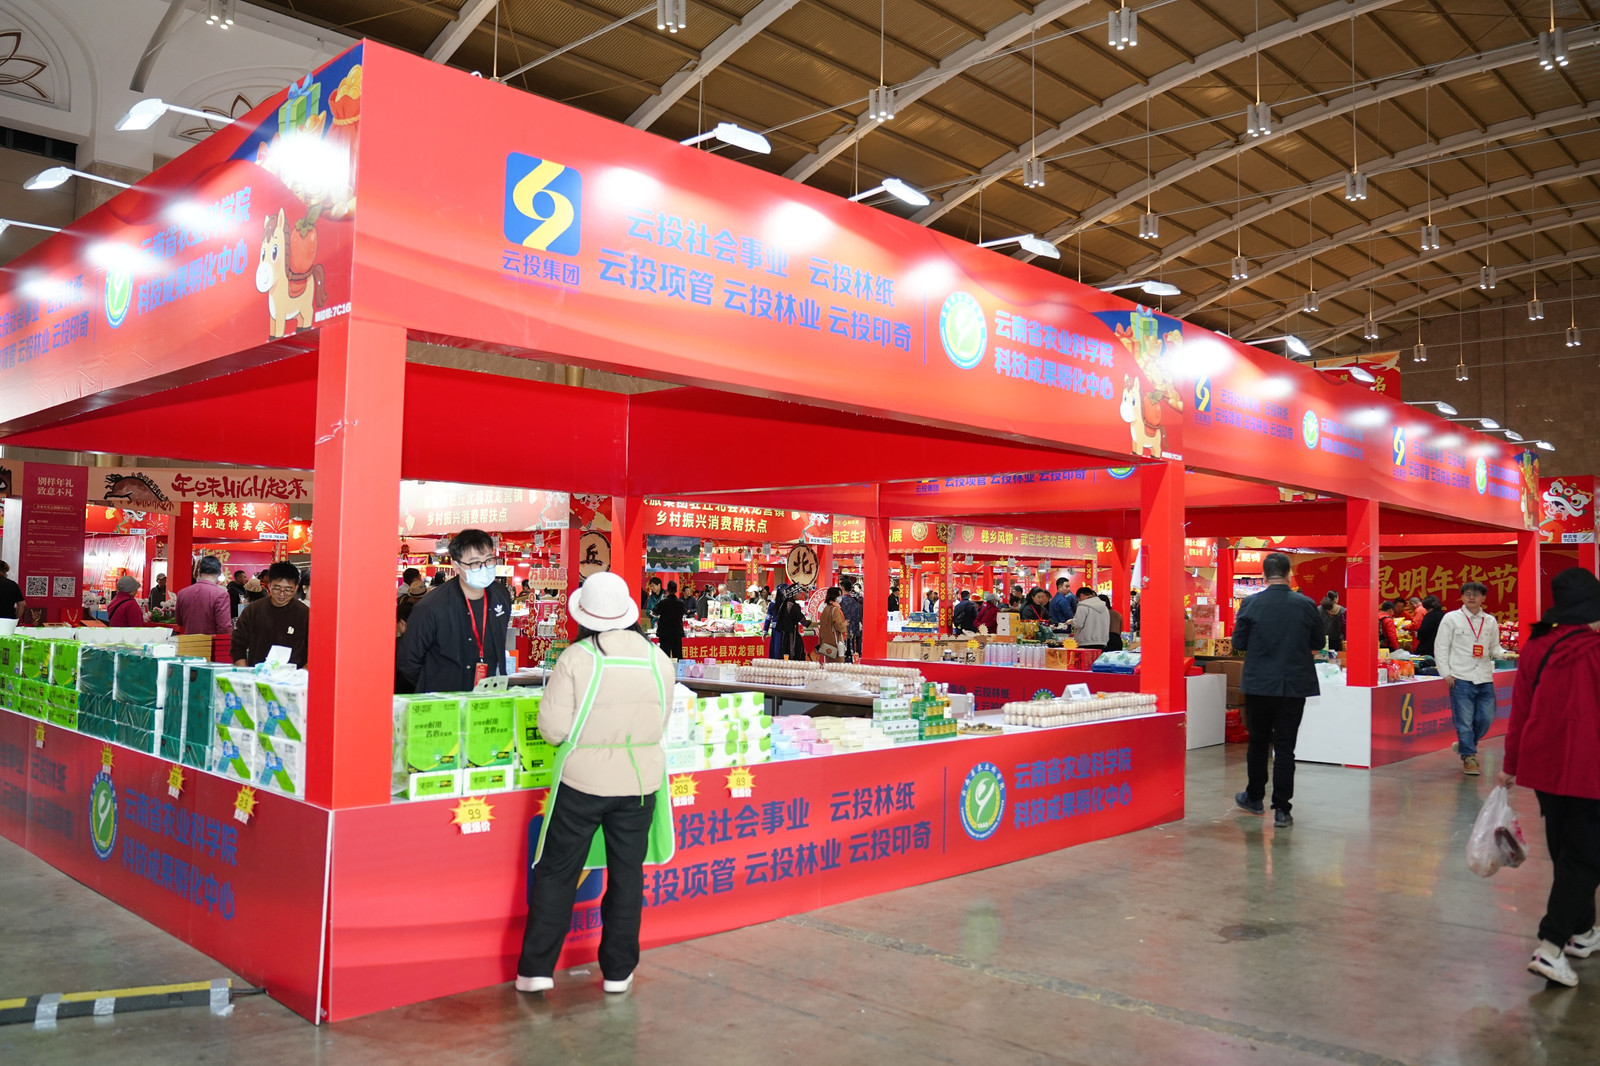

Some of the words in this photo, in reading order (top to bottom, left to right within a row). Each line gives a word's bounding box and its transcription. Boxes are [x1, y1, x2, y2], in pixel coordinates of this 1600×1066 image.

[502, 249, 580, 286] 云投集团
[626, 208, 789, 279] 云投社会事业
[808, 255, 896, 309] 云投林纸
[597, 248, 714, 306] 云投项管
[722, 279, 821, 331] 云投林业
[828, 305, 913, 352] 云投印奇
[995, 309, 1114, 368] 云南省农业科学院
[994, 347, 1114, 400] 科技成果孵化中心
[427, 508, 508, 527] 乡村振兴消费帮扶点
[655, 510, 768, 534] 乡村振兴消费帮扶点
[792, 551, 814, 576] 北
[1015, 747, 1132, 789] 云南省农业科学院
[124, 788, 238, 867] 云南省农业科学院
[673, 797, 809, 851] 投社会事业
[830, 781, 915, 822] 云投林纸
[1014, 781, 1132, 830] 科技成果孵化中心
[122, 835, 235, 921] 科技成果孵化中心
[745, 838, 841, 886] 云投林业
[848, 821, 931, 864] 云投印奇
